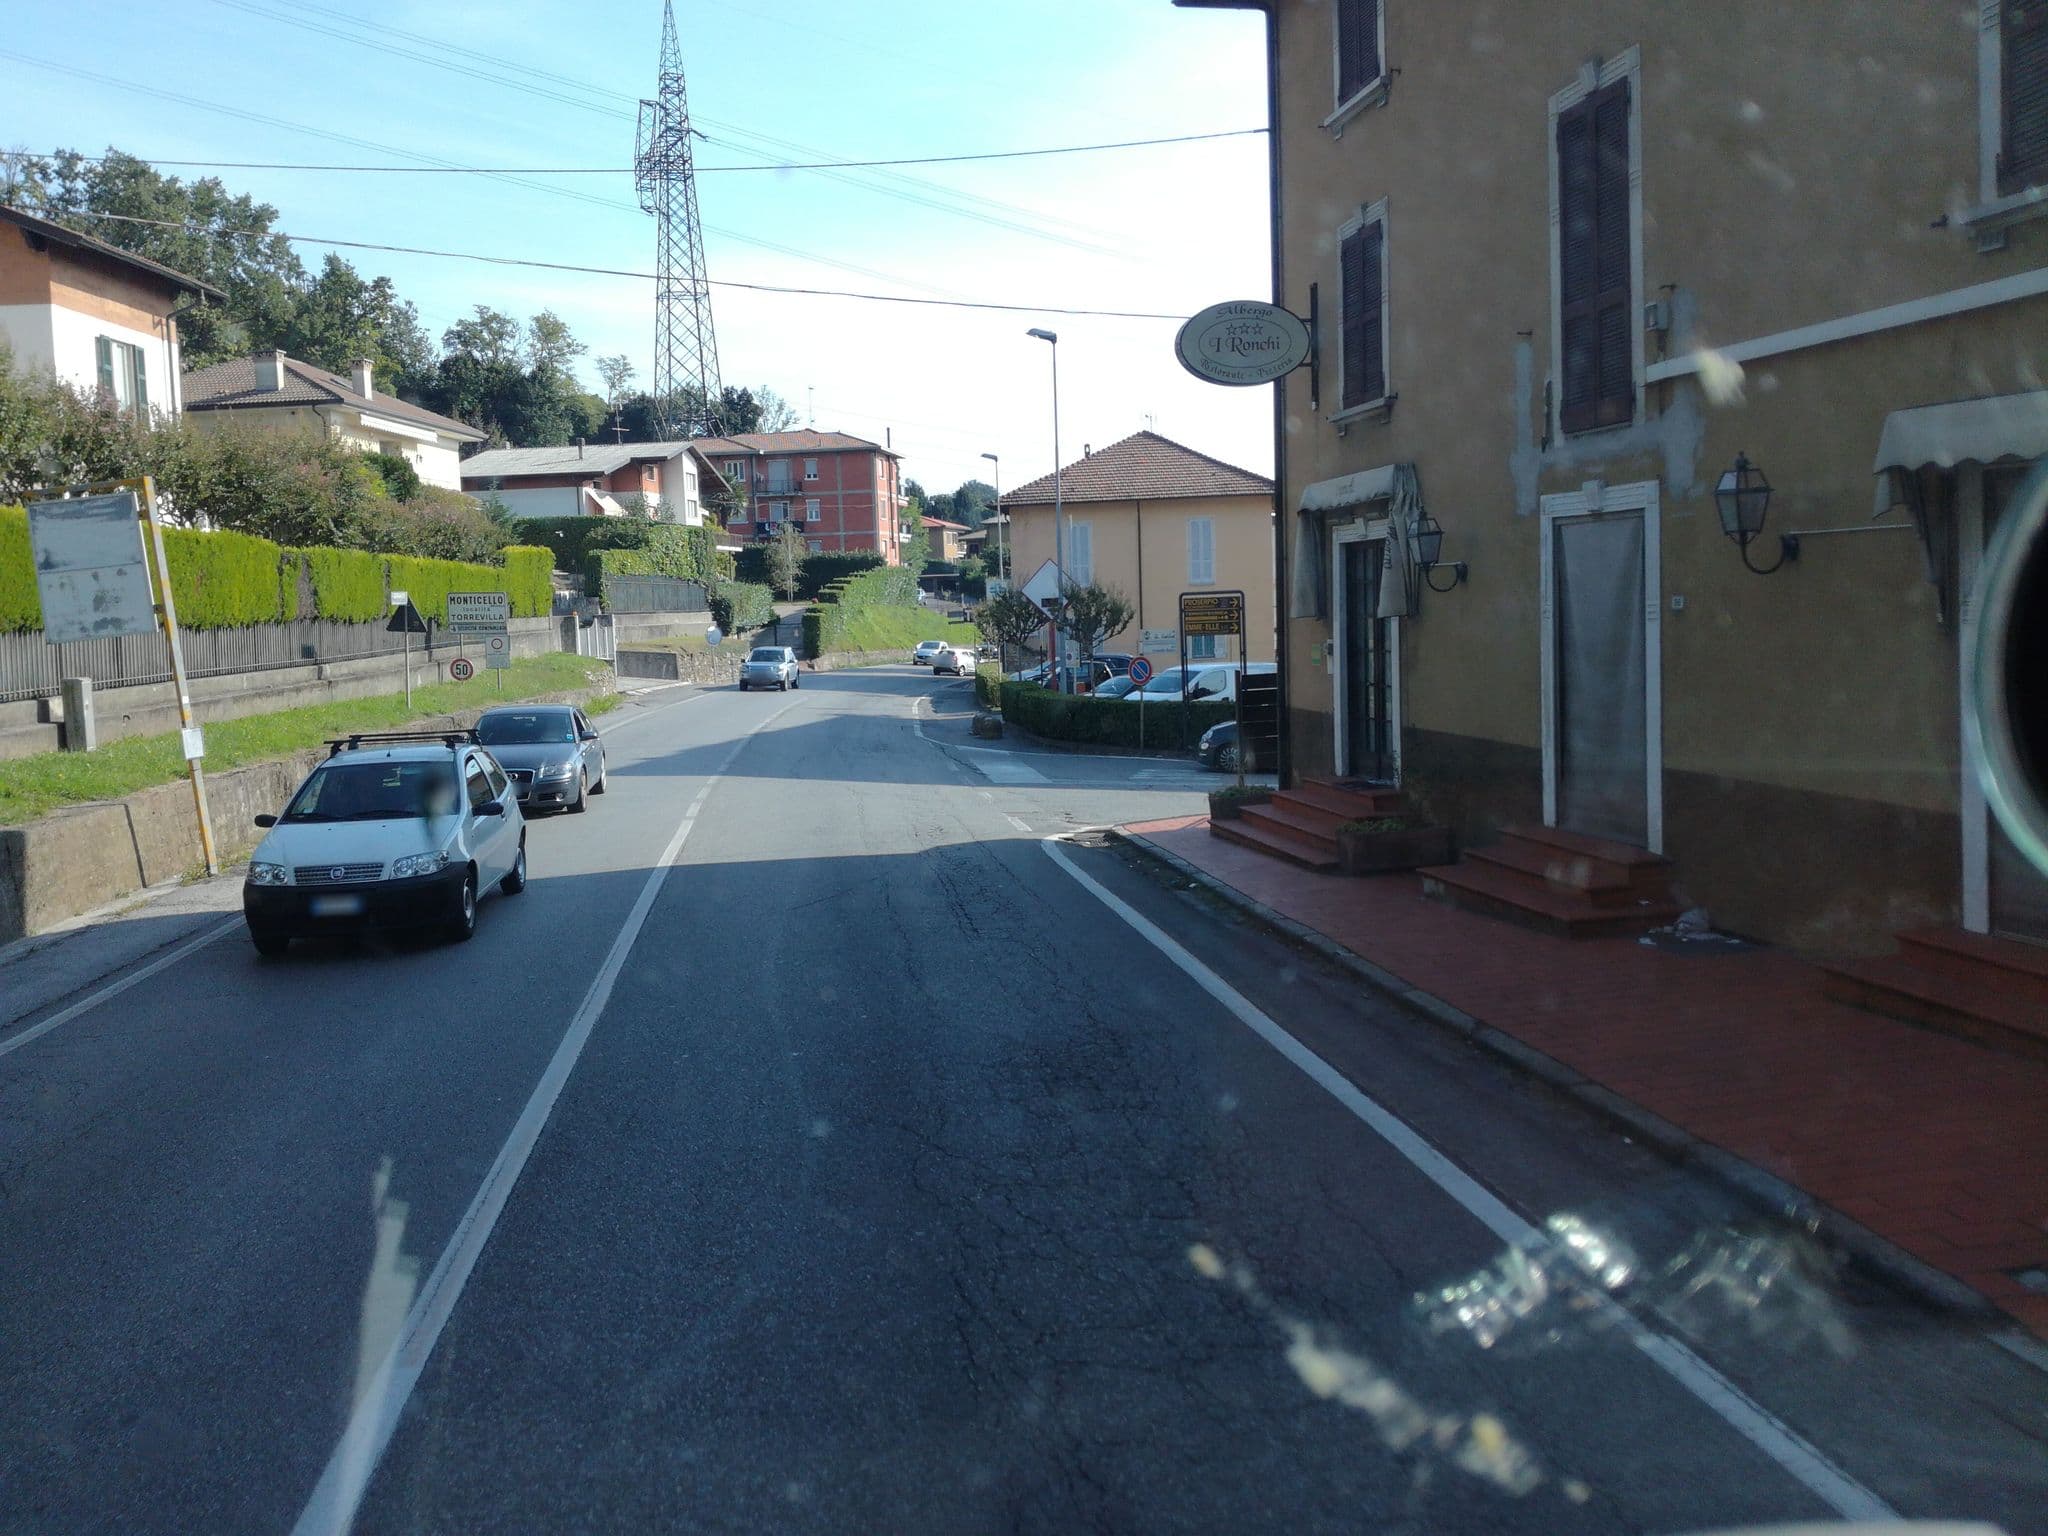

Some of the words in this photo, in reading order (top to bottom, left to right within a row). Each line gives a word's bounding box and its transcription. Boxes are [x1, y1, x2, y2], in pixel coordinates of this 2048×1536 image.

[1215, 304, 1273, 319] Albergo
[1225, 336, 1281, 357] Ronchi
[449, 596, 503, 605] MONTICELLO
[456, 664, 468, 675] 50
